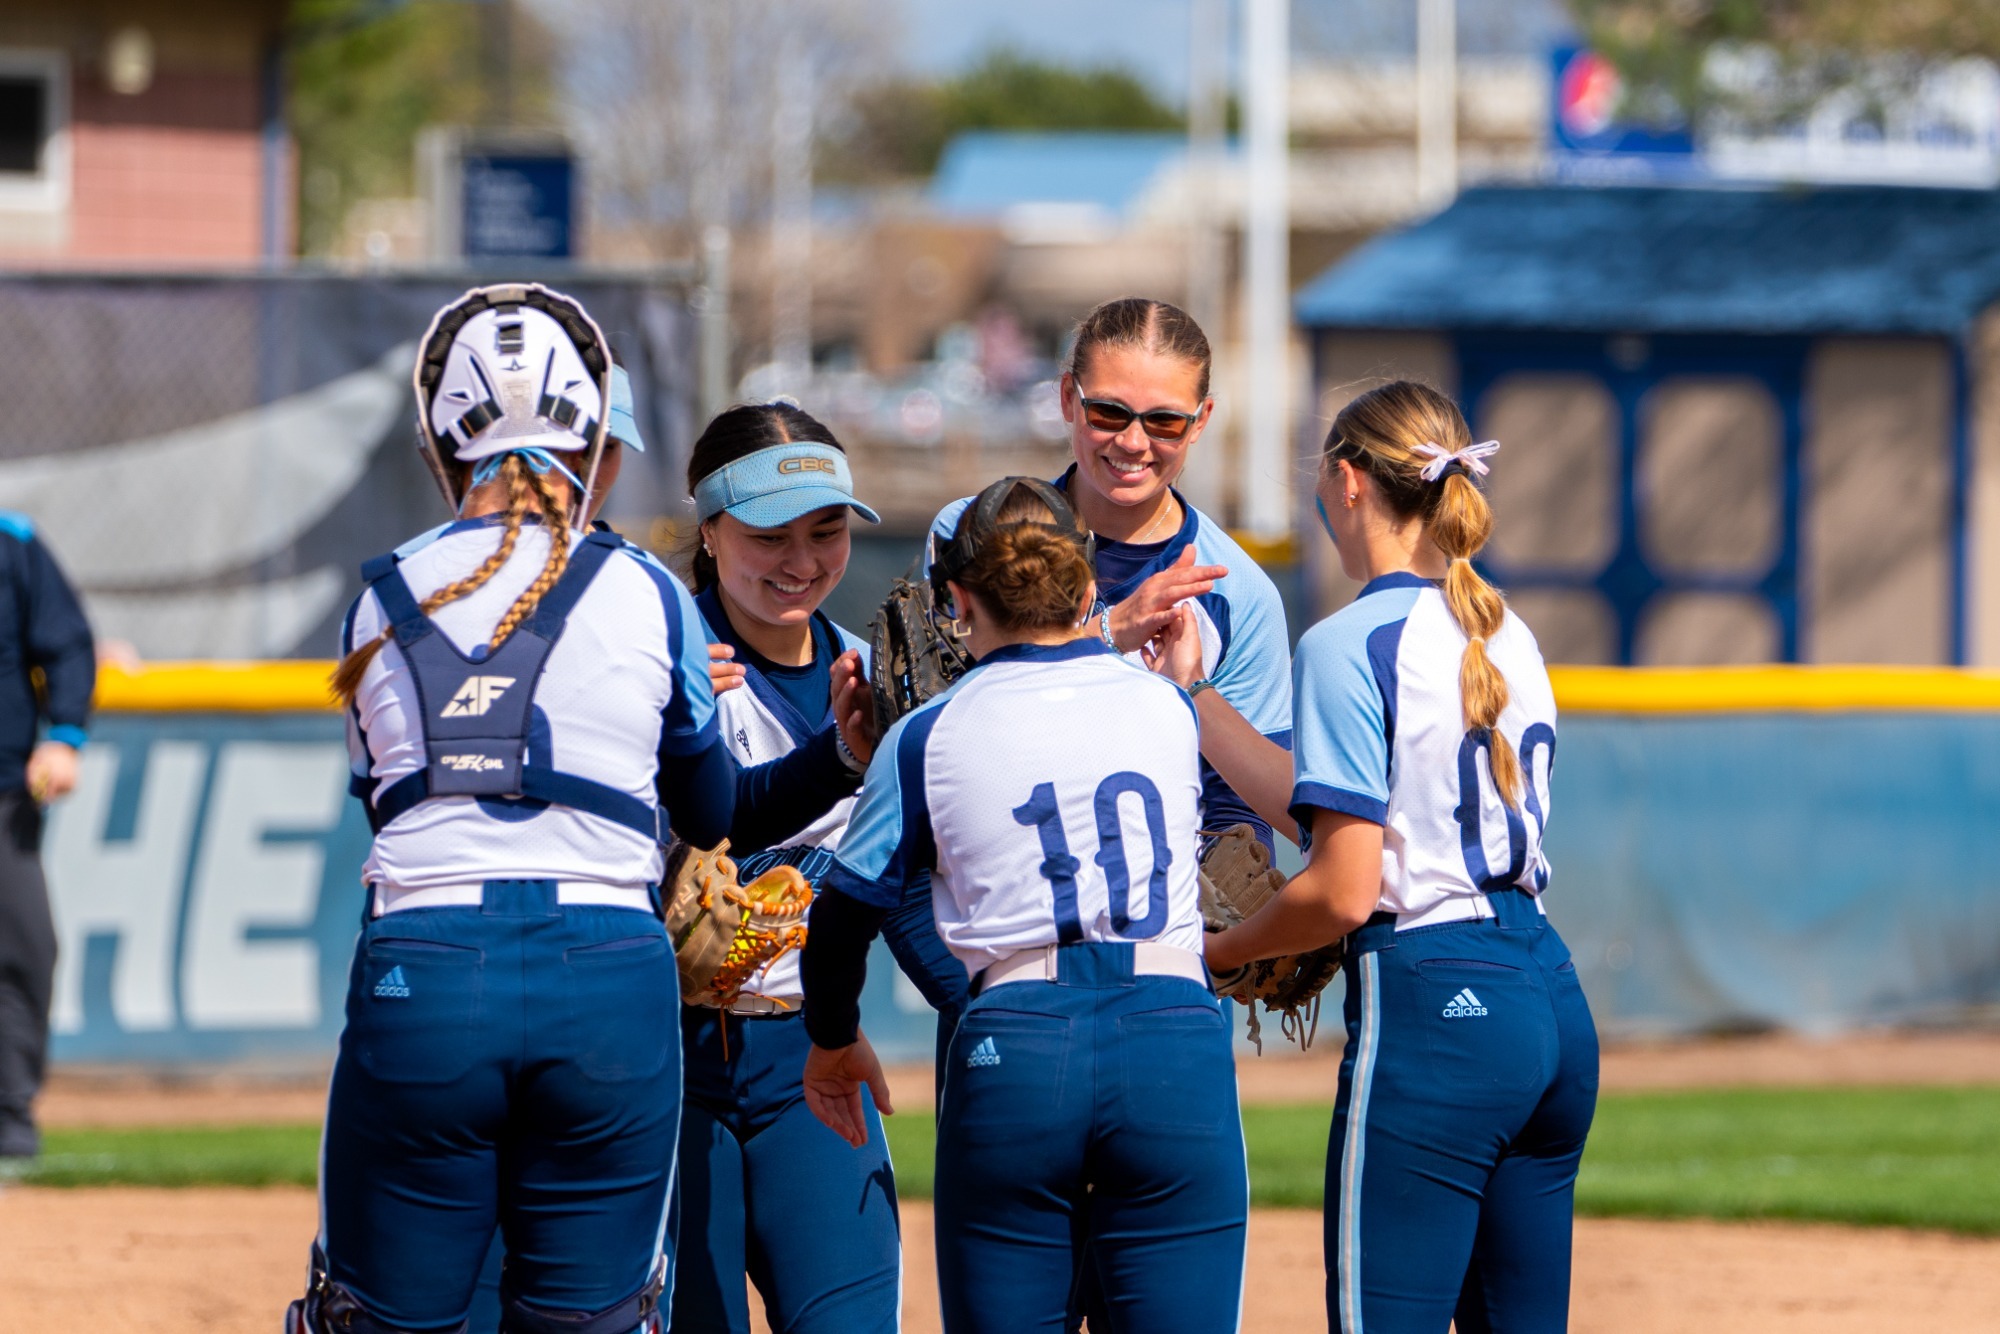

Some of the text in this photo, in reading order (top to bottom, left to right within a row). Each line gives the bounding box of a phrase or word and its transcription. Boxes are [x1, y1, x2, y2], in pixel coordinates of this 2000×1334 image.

[778, 457, 836, 475] CBC
[440, 676, 517, 717] AF
[1012, 771, 1173, 942] 10
[1442, 1005, 1489, 1018] adidas
